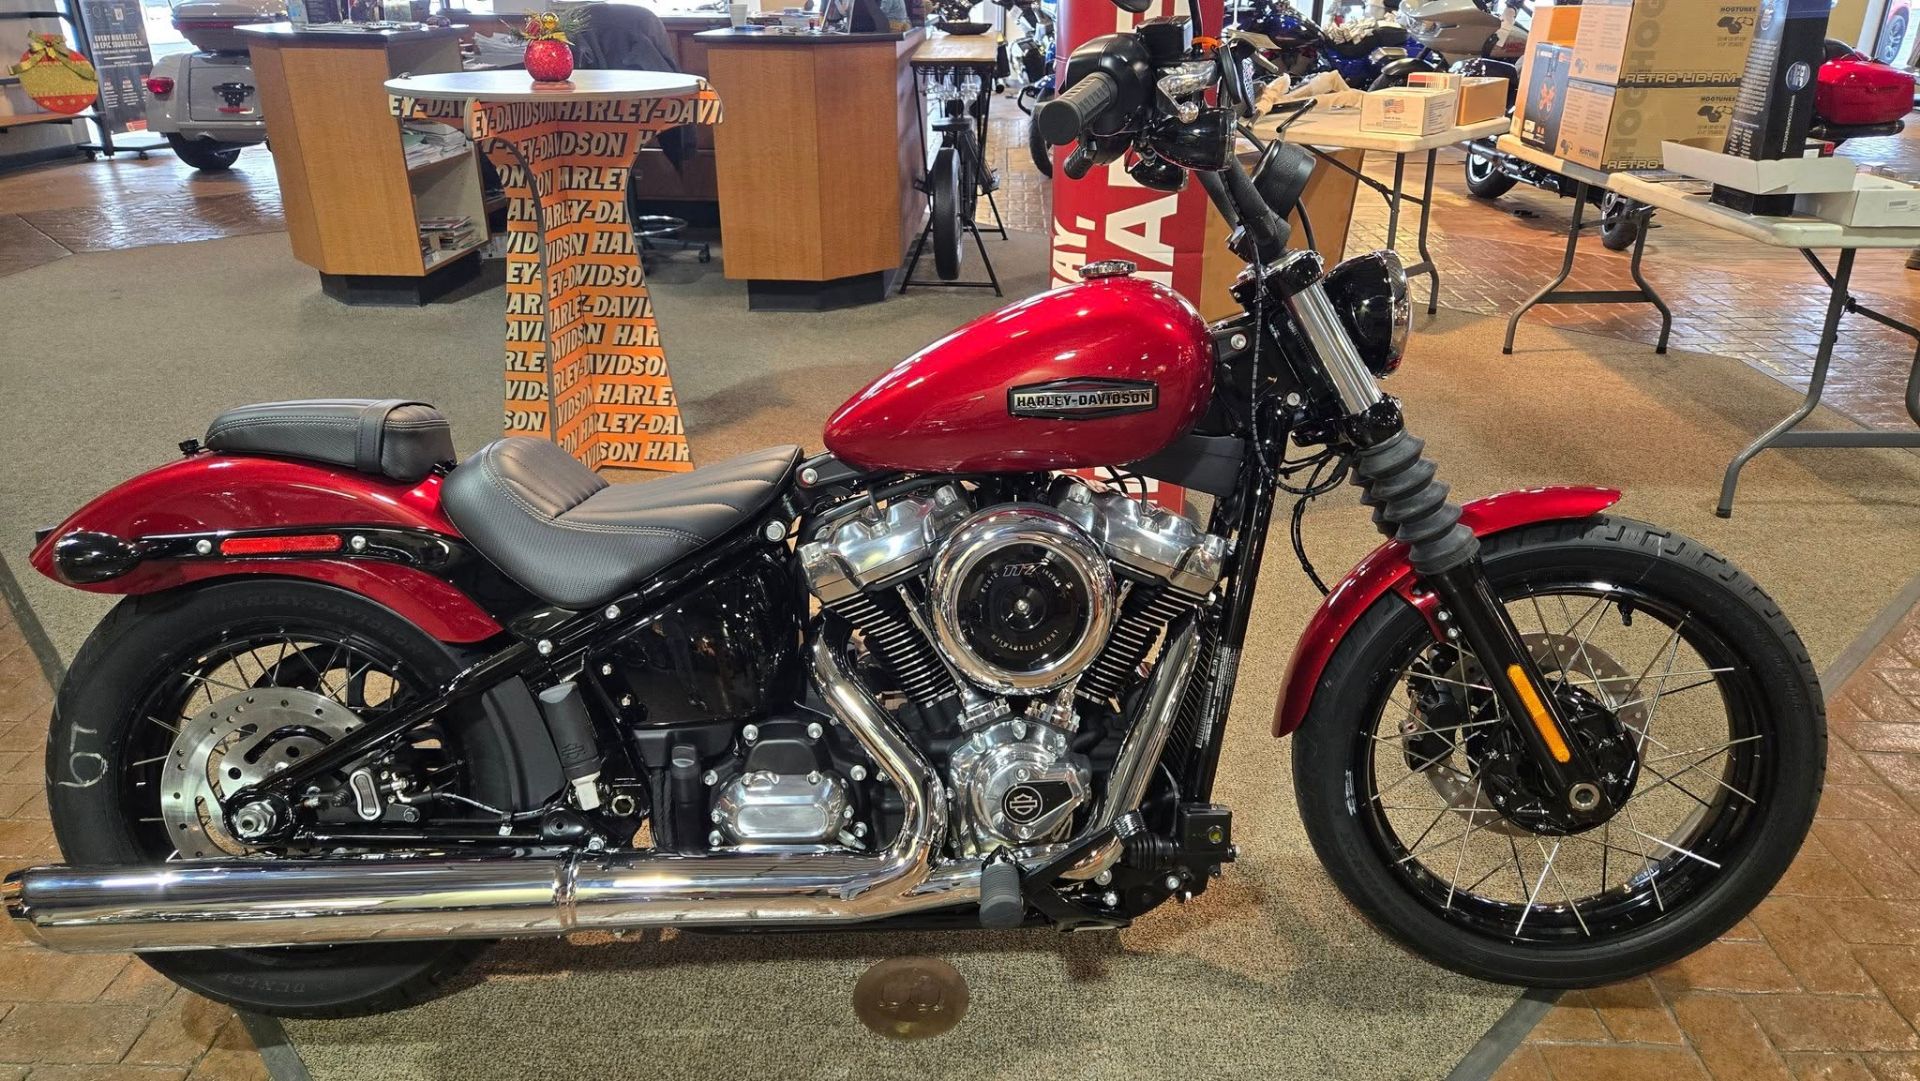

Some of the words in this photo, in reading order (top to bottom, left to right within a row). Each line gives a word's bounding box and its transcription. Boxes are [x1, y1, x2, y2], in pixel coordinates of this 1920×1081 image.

[1624, 72, 1678, 83] RETRO
[1607, 159, 1659, 170] RETRO
[594, 383, 677, 407] HARLE
[1017, 392, 1151, 408] HARLEY-DAVIDSON
